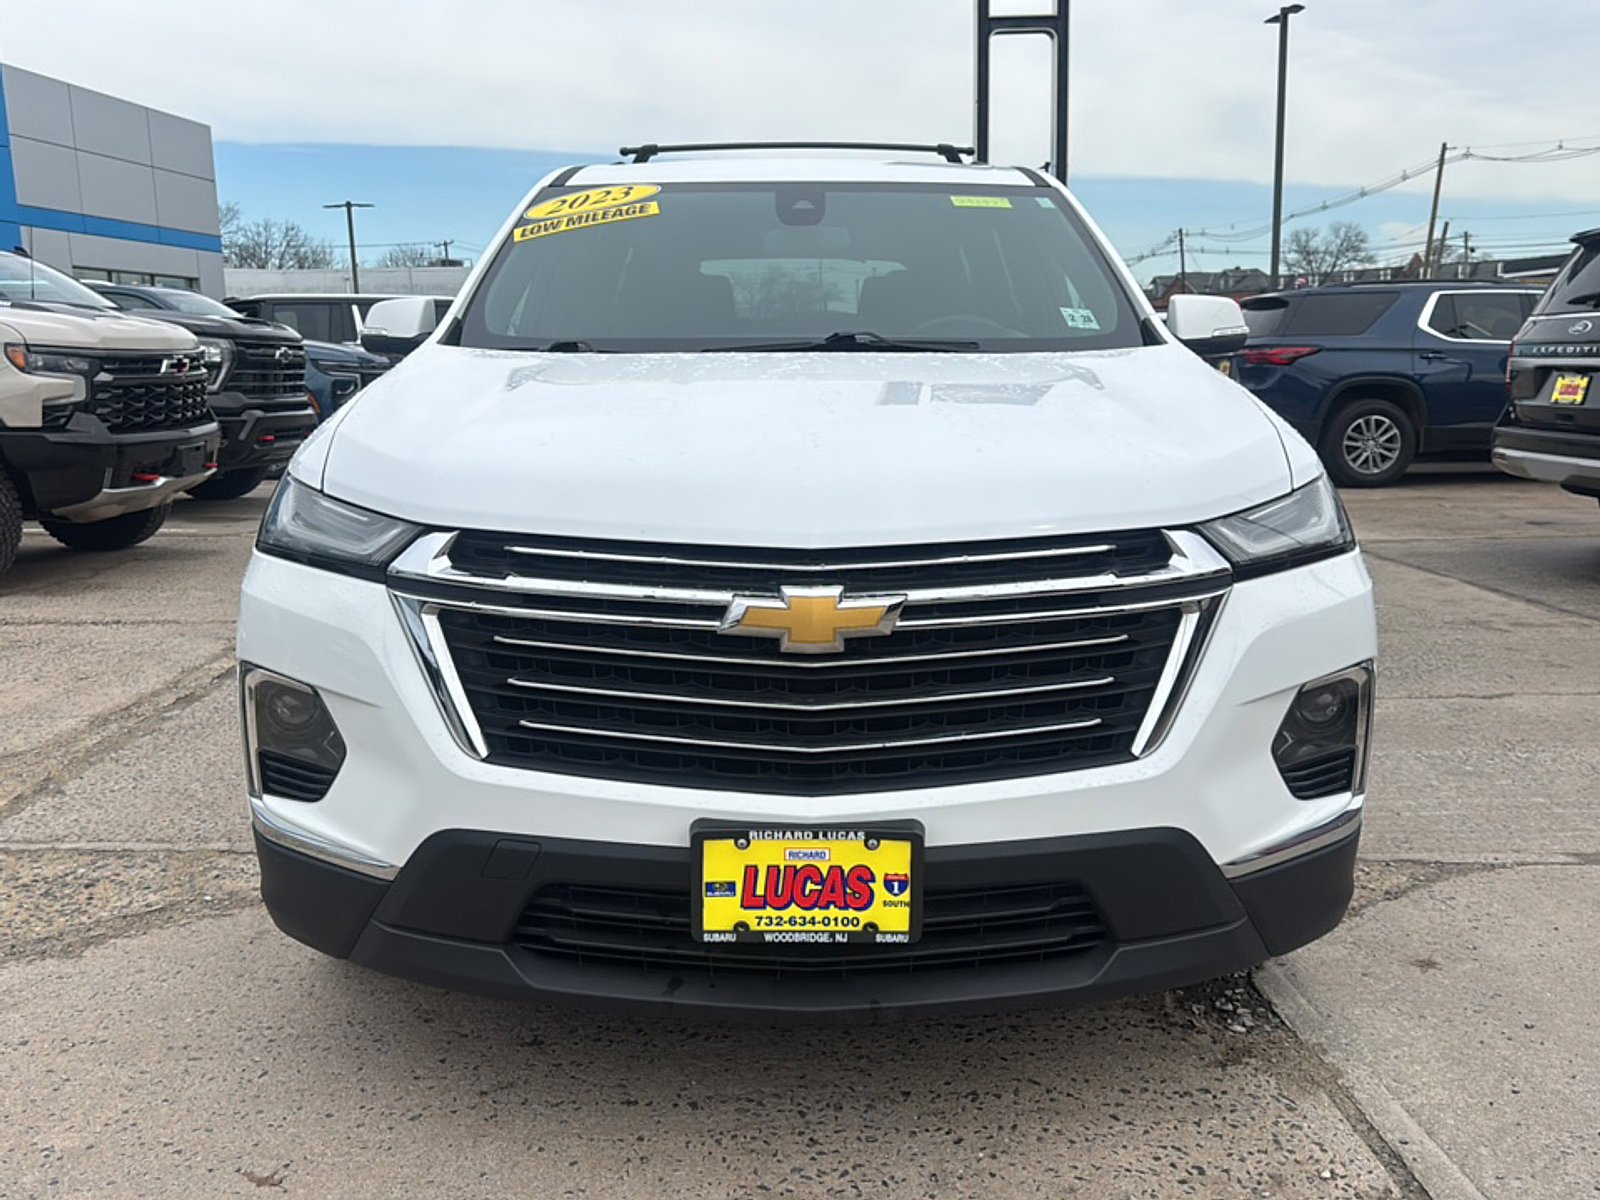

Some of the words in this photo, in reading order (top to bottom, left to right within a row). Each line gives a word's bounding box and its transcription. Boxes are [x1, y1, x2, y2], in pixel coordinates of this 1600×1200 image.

[546, 186, 634, 215] 2023
[520, 220, 562, 238] LOW
[565, 204, 650, 227] MILEAGE
[749, 830, 813, 841] RICHARD
[818, 830, 866, 841] LUCAS
[787, 850, 828, 860] RICHARD
[740, 864, 876, 912] LUCAS
[891, 880, 900, 895] 1
[883, 900, 910, 908] SOUTH
[755, 916, 860, 927] 732-634-0100
[703, 932, 737, 942] SUBARU
[835, 932, 849, 943] NJ
[875, 933, 910, 943] SUBARU
